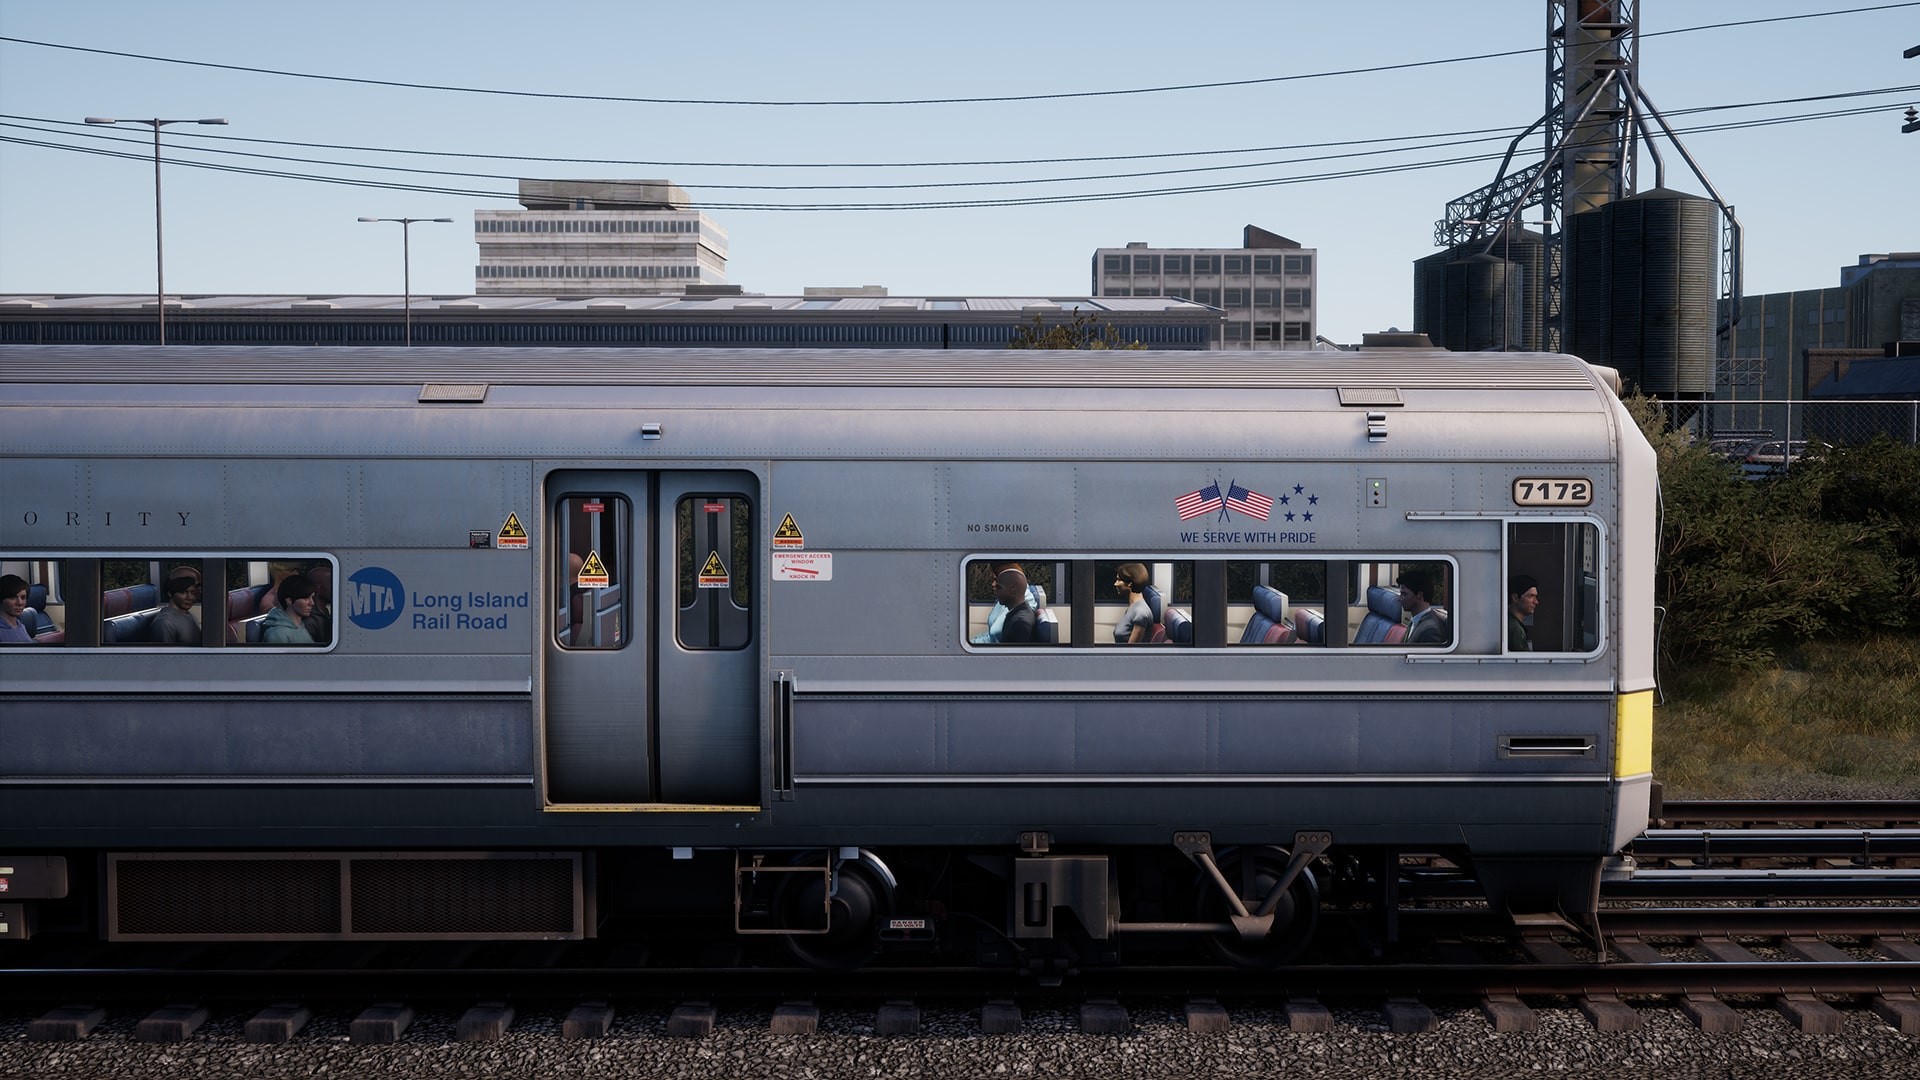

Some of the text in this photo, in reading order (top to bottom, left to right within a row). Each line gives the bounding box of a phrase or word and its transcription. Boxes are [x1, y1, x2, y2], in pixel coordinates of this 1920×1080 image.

[1519, 482, 1587, 500] 7172
[967, 523, 1030, 533] NO SMOKING
[1180, 531, 1317, 543] WE SERVE WITH PRIDE
[349, 580, 396, 617] MTA
[412, 591, 528, 612] Long Island
[412, 613, 508, 630] Rail Road
